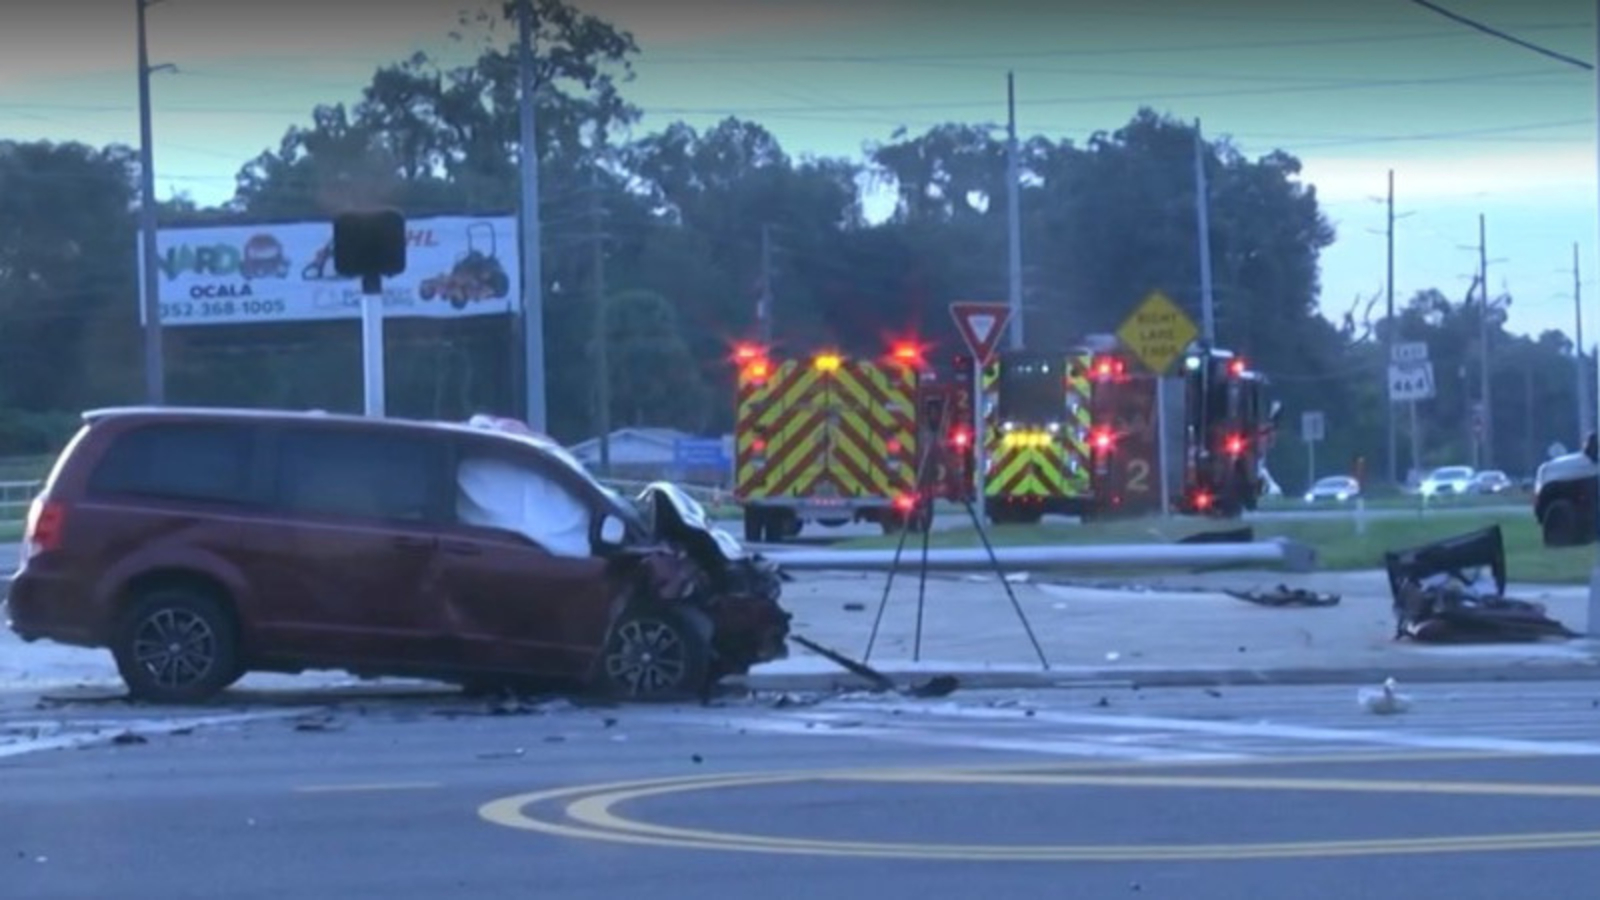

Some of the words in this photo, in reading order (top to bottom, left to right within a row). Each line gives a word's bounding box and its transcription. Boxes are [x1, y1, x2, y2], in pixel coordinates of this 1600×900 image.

[189, 283, 253, 299] OCALA
[1393, 377, 1425, 392] 464
[1126, 459, 1150, 492] 2
